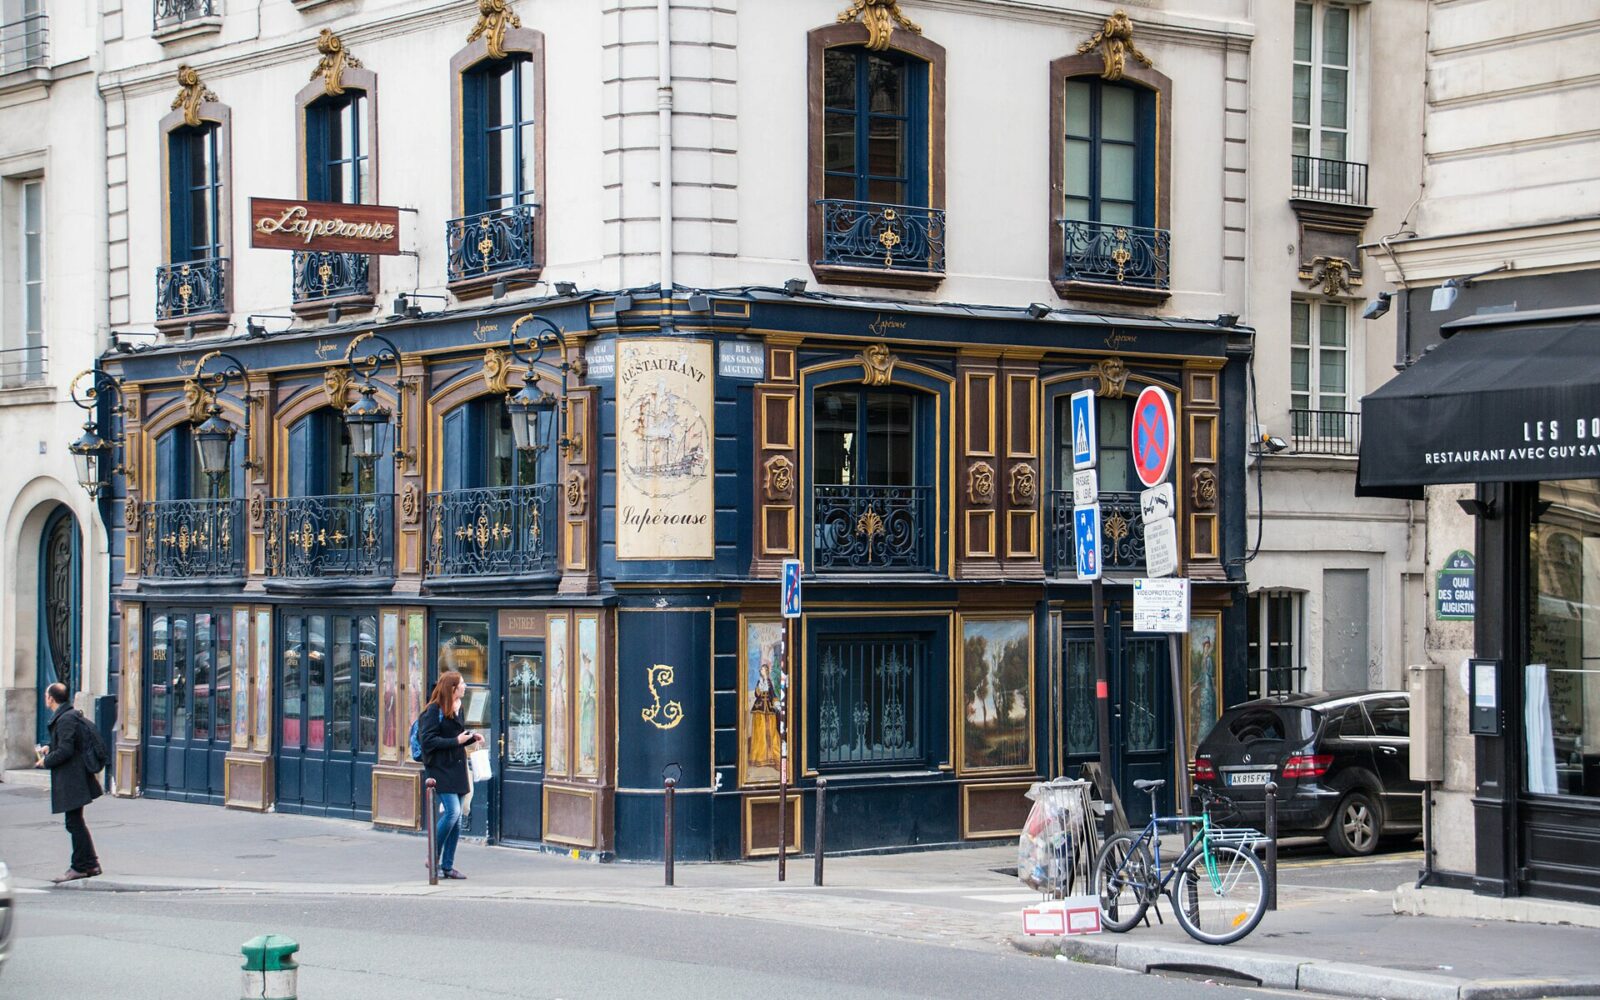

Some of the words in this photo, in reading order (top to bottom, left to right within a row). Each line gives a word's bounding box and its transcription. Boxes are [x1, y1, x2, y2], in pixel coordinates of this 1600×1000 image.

[256, 205, 395, 244] Laperouse
[735, 344, 752, 353] RUE
[721, 354, 735, 363] DES
[736, 355, 763, 365] GRANDS
[621, 358, 706, 384] RESTAURANT
[724, 365, 763, 374] AUGUSTINS
[1523, 420, 1559, 442] LES
[1425, 450, 1505, 464] RESTAURANT
[1508, 447, 1545, 460] AVEC
[1548, 445, 1576, 458] GUY
[622, 506, 707, 533] Lapérouse
[1452, 577, 1470, 588] QUAI
[1438, 589, 1452, 600] DES
[1454, 590, 1474, 601] GRAN
[1441, 602, 1474, 613] AUGUSTIN
